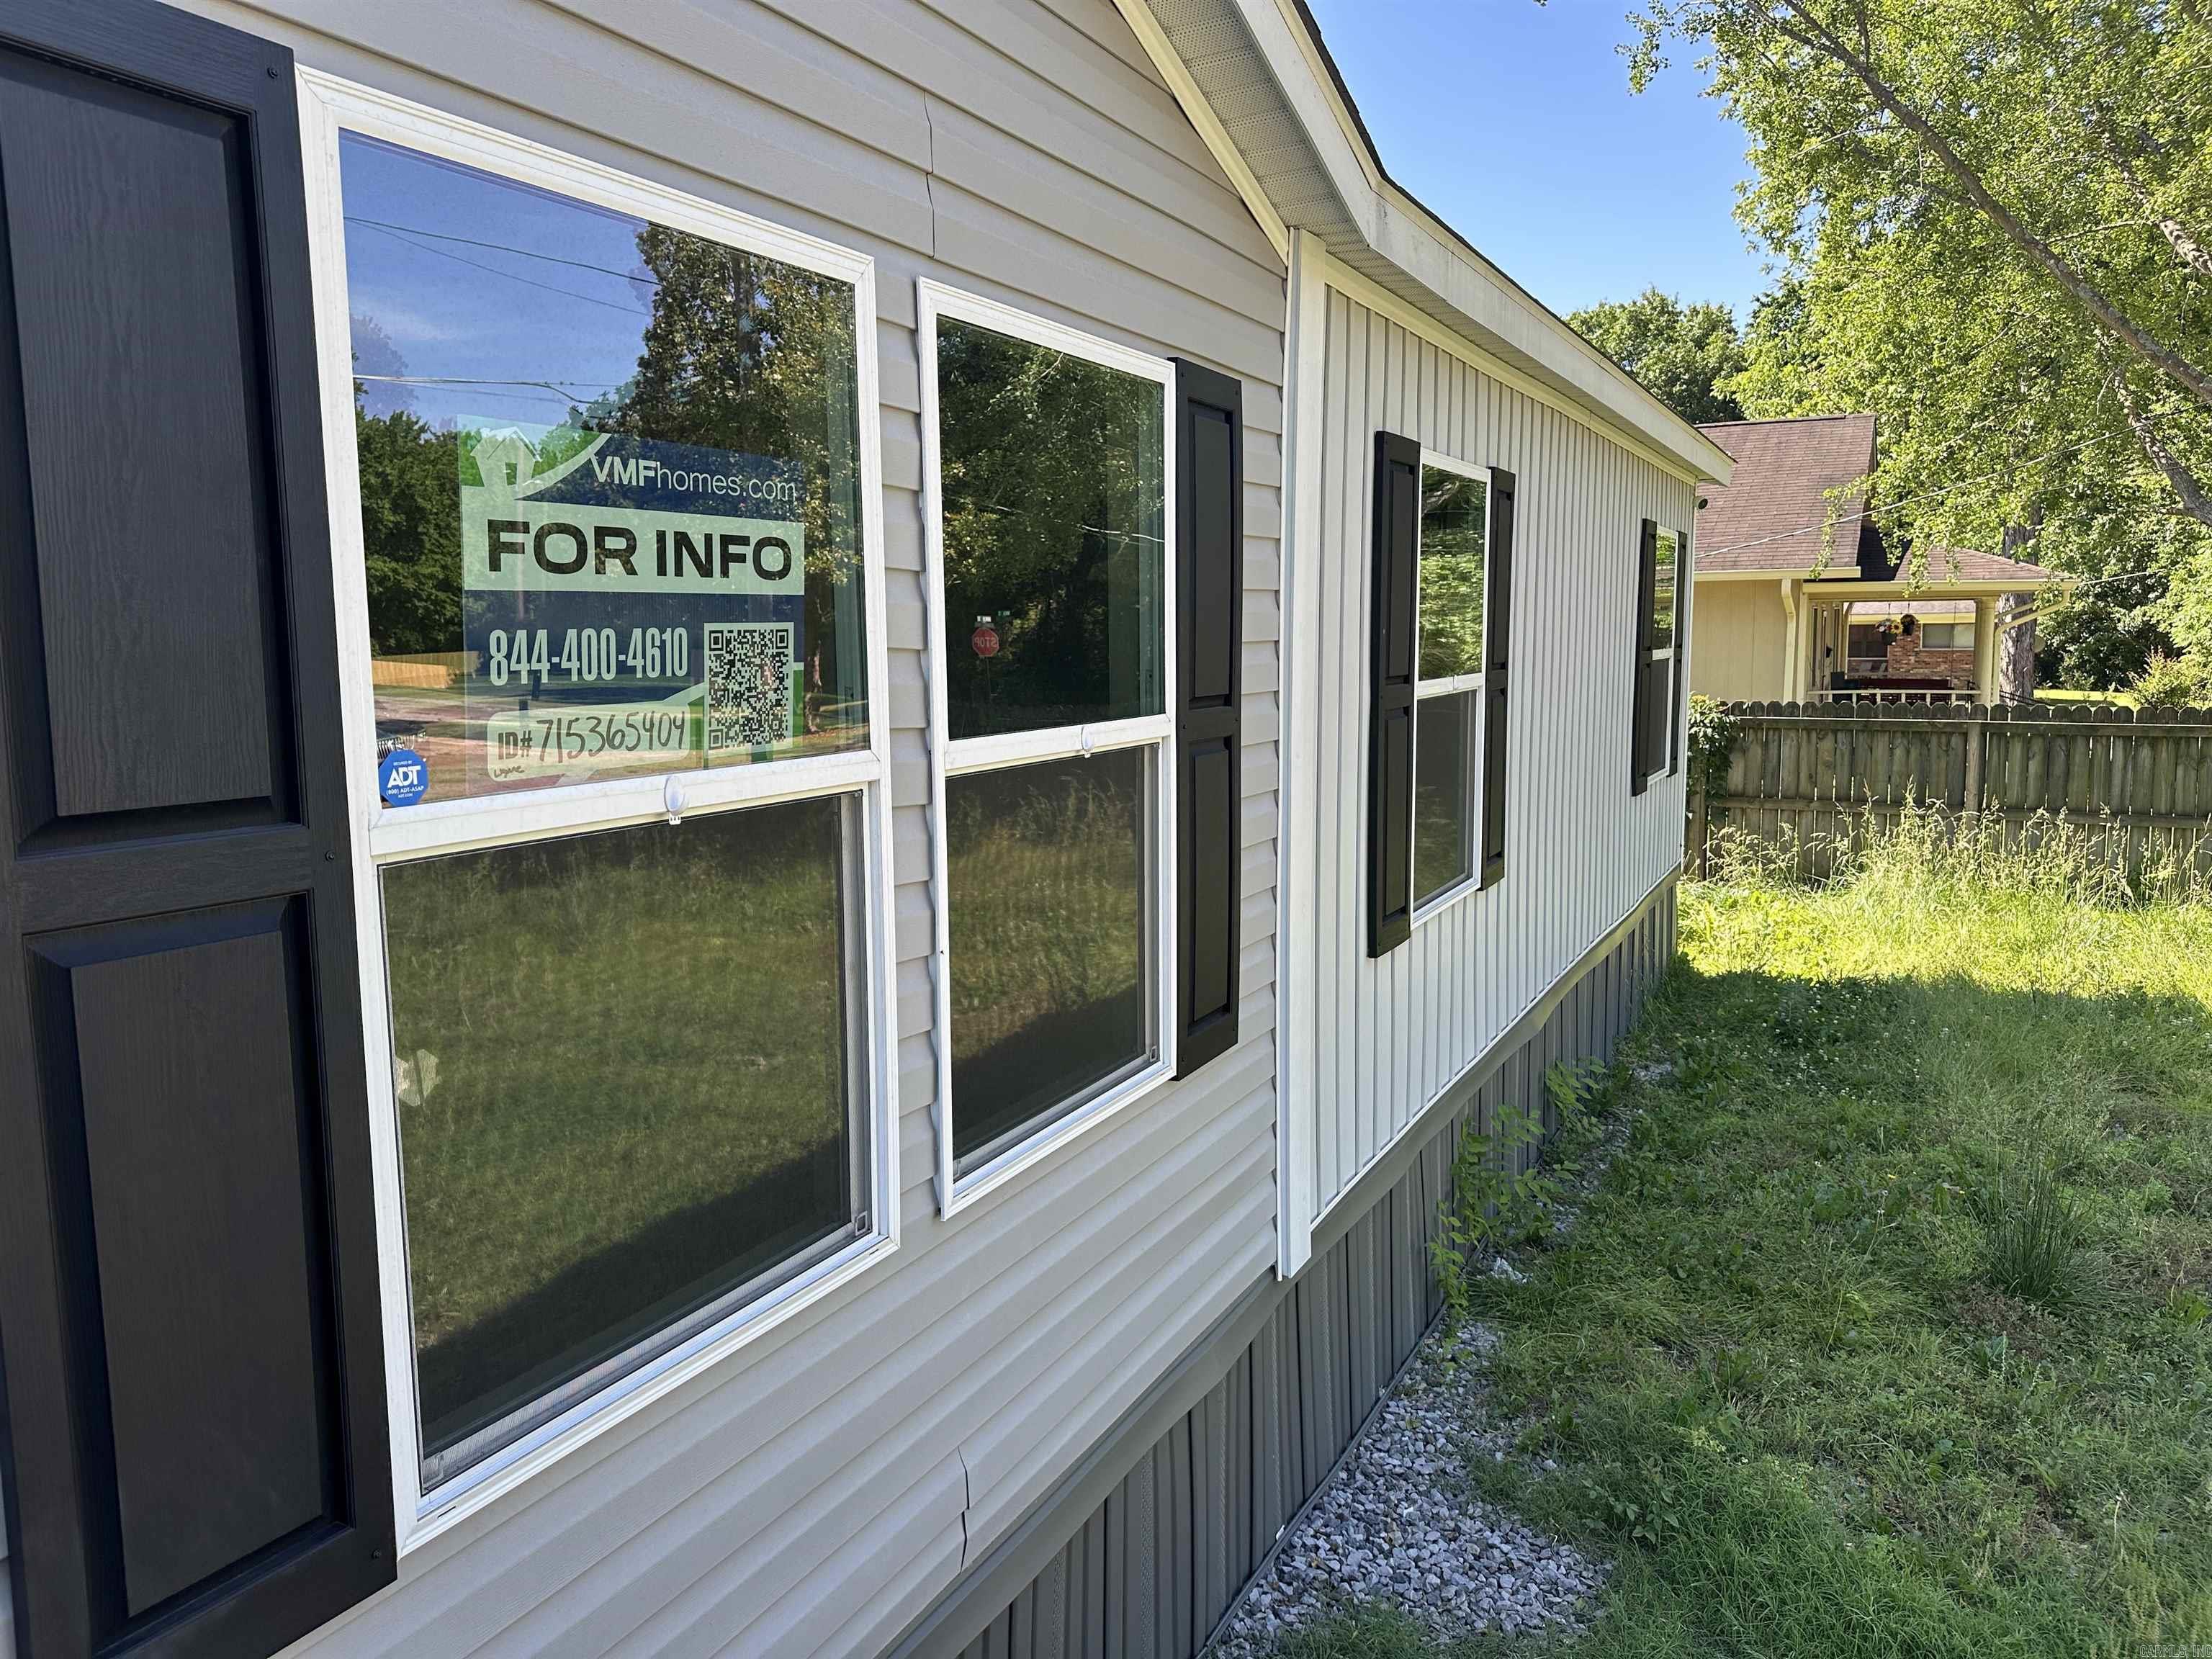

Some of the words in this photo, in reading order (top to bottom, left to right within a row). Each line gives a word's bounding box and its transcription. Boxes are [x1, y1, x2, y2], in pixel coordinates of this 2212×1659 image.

[589, 455, 796, 501] VMFhomes.com
[487, 518, 638, 576] FOR
[656, 529, 792, 581] INFO
[489, 627, 688, 686] 844-400-4610
[498, 729, 533, 760] ID#
[536, 710, 685, 764] 715365404
[387, 765, 421, 788] ADT
